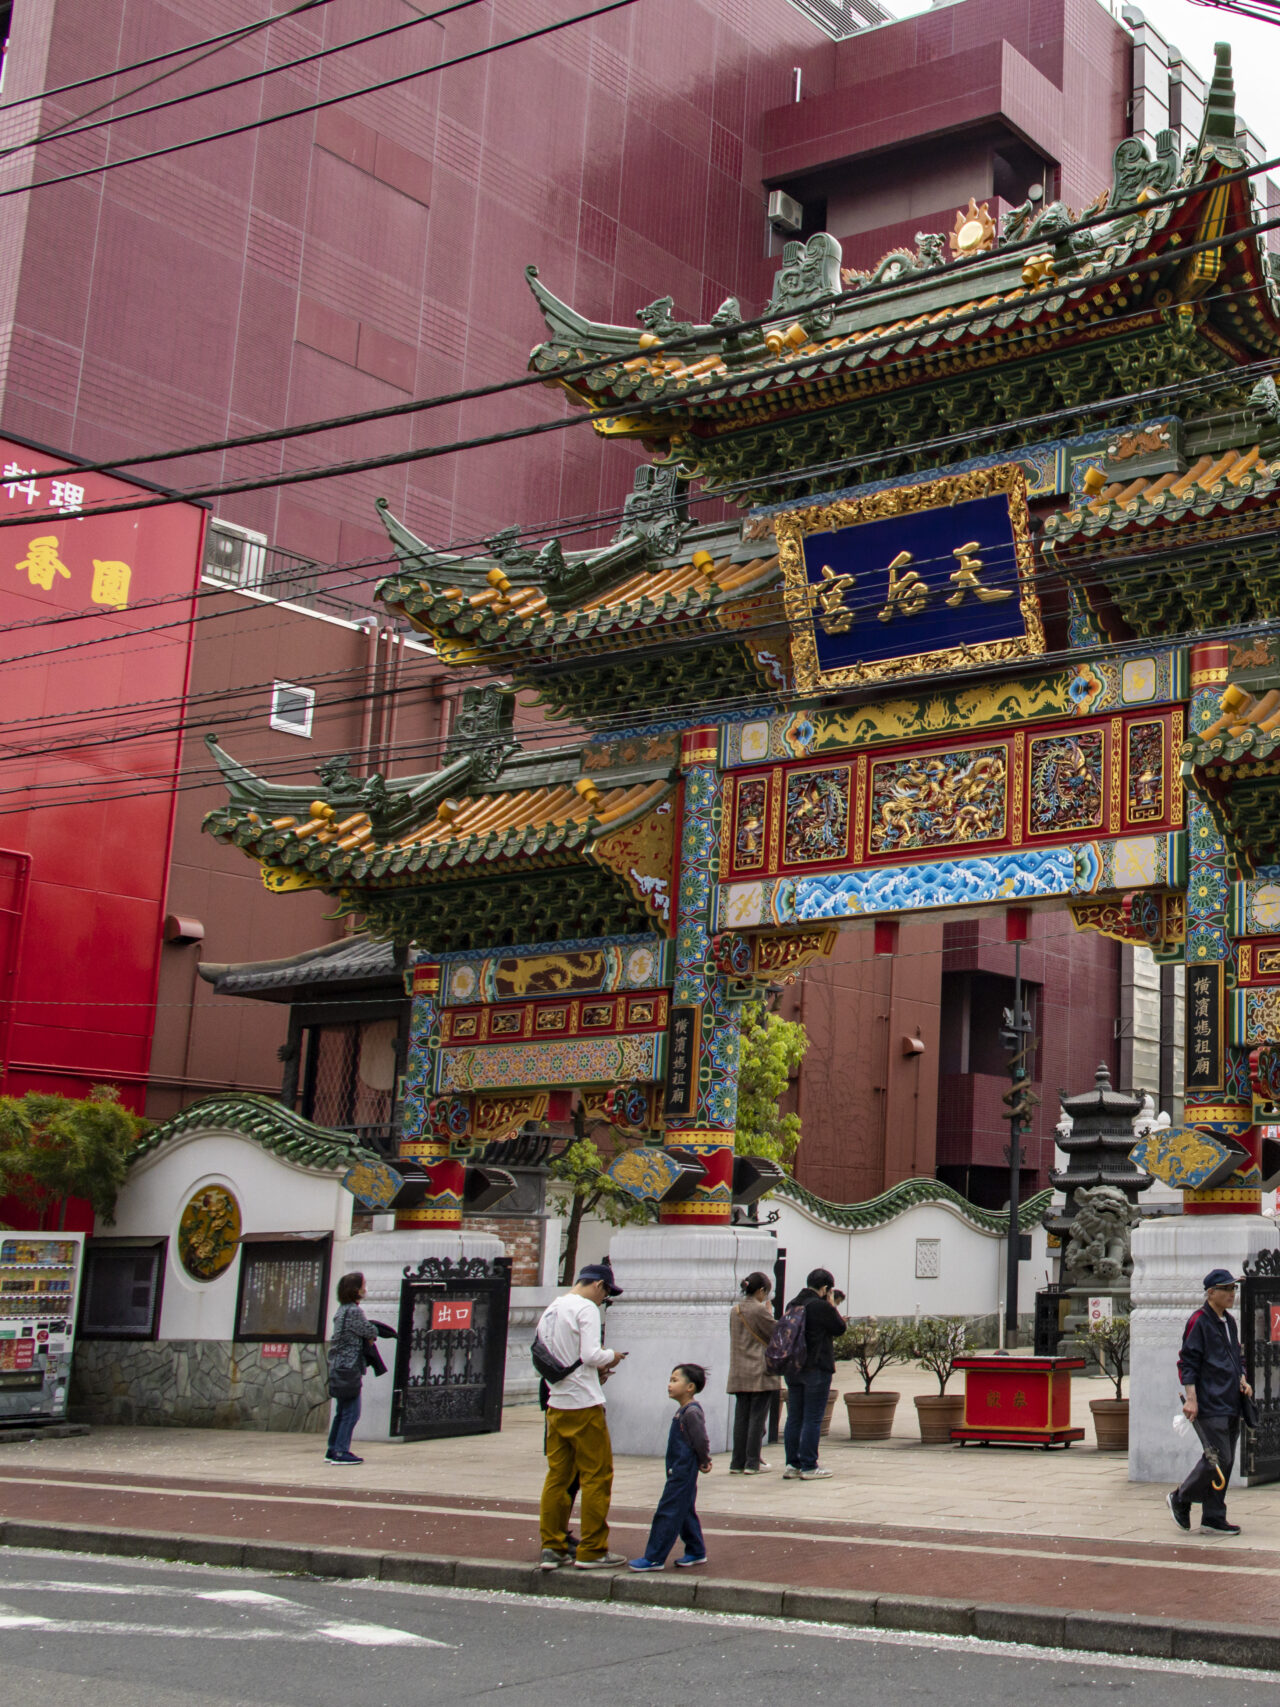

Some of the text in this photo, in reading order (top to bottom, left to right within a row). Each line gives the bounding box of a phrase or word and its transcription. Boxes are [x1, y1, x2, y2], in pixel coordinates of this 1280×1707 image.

[3, 461, 85, 521] 料理
[809, 541, 1014, 635] 天后宮
[437, 1305, 469, 1323] 出口
